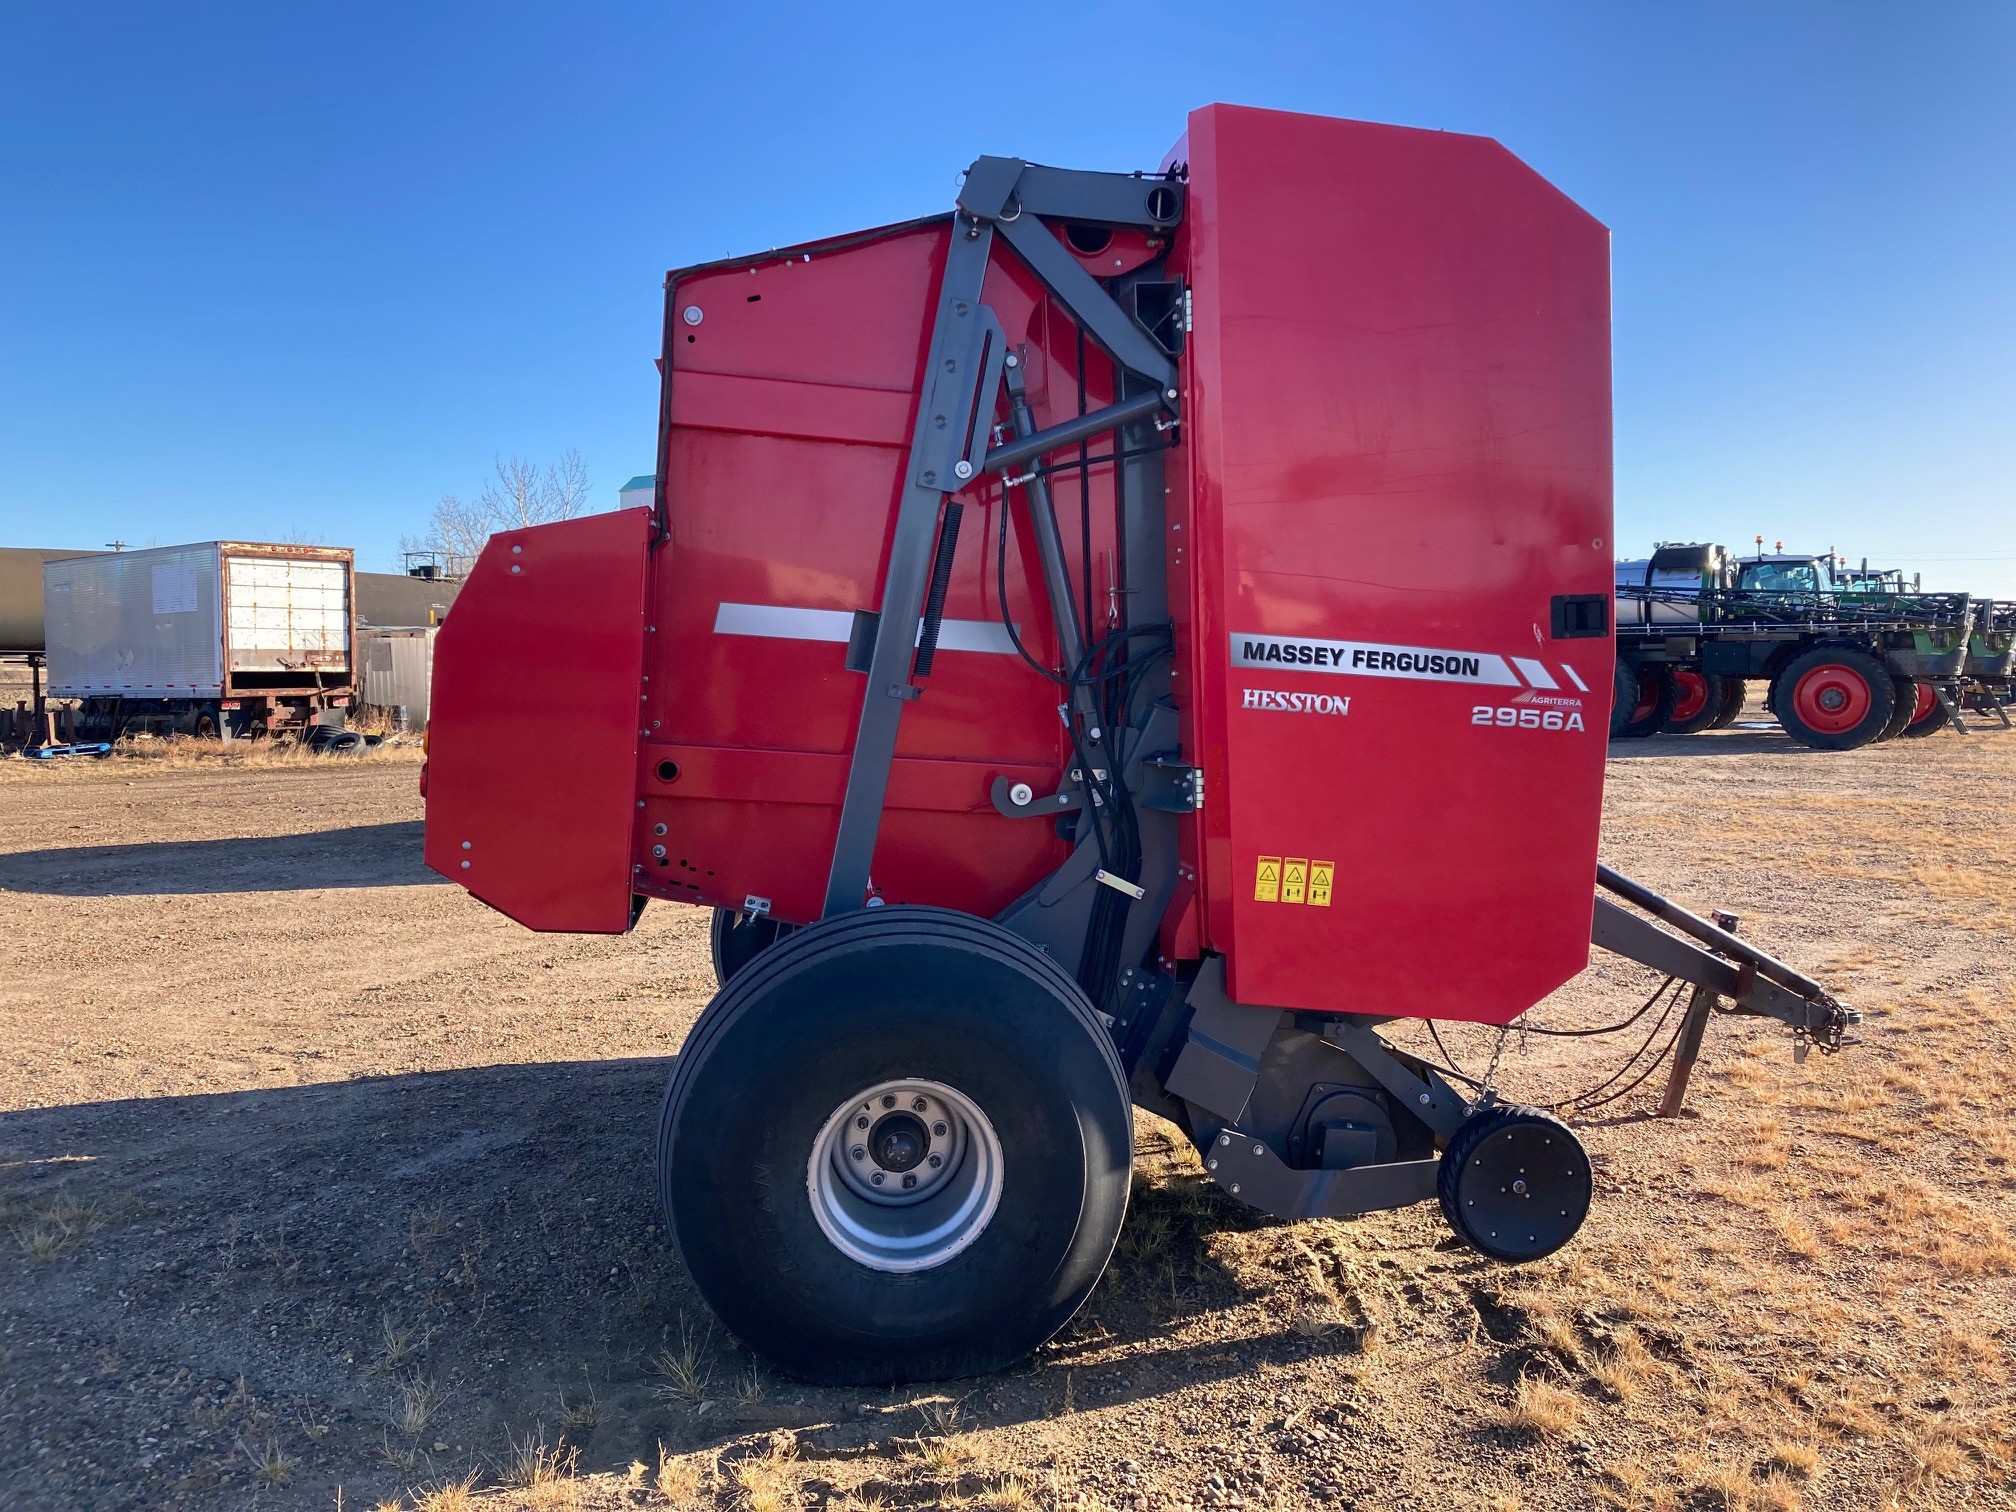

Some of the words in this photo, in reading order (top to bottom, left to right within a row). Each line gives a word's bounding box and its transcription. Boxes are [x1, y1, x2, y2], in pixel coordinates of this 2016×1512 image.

[1243, 641, 1344, 667] MASSEY
[1352, 649, 1480, 677] FERGUSON
[1241, 688, 1351, 716] HESSTON
[1531, 696, 1582, 707] AGRITERRA
[1471, 705, 1585, 732] 2956A
